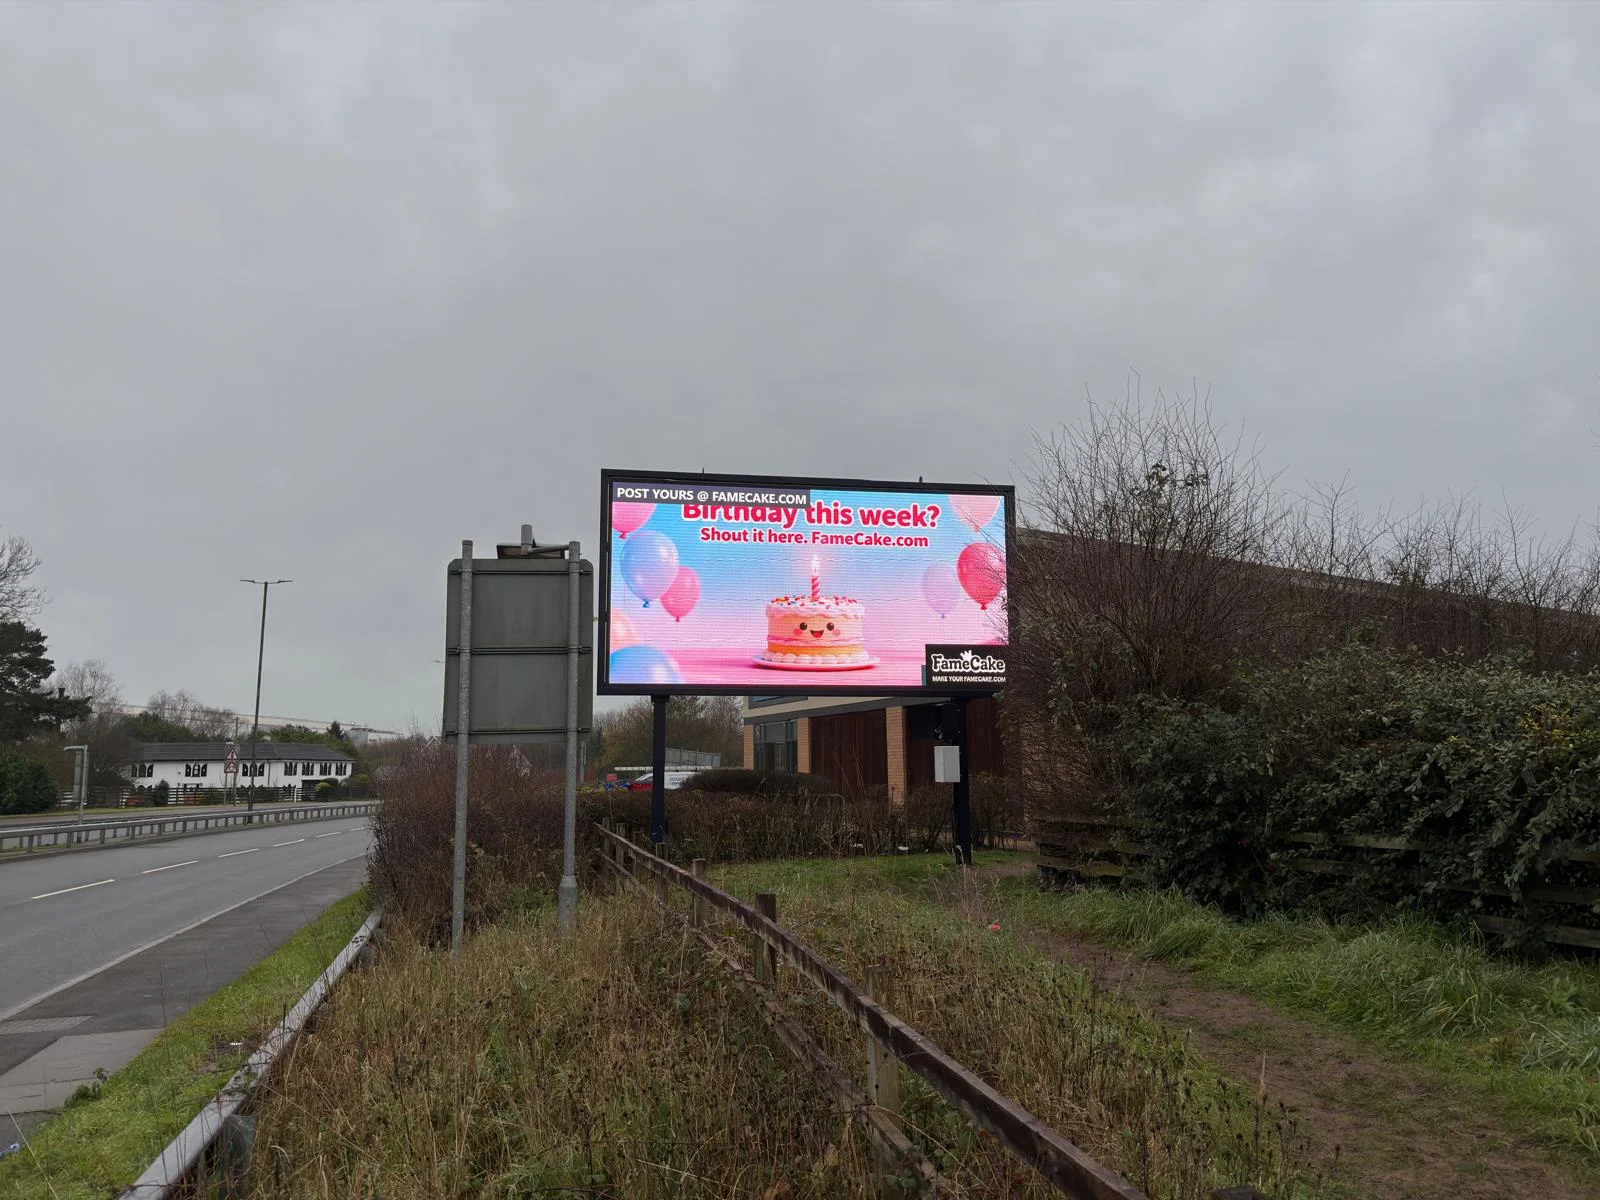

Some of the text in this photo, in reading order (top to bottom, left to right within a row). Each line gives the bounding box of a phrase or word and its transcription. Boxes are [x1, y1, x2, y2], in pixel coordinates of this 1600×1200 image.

[617, 487, 807, 504] POST YOURS @ FAMECAKE.COM
[682, 501, 940, 528] Birthday this week?
[700, 527, 929, 547] Shout it here. FameCake.com
[931, 653, 1006, 673] FameCake
